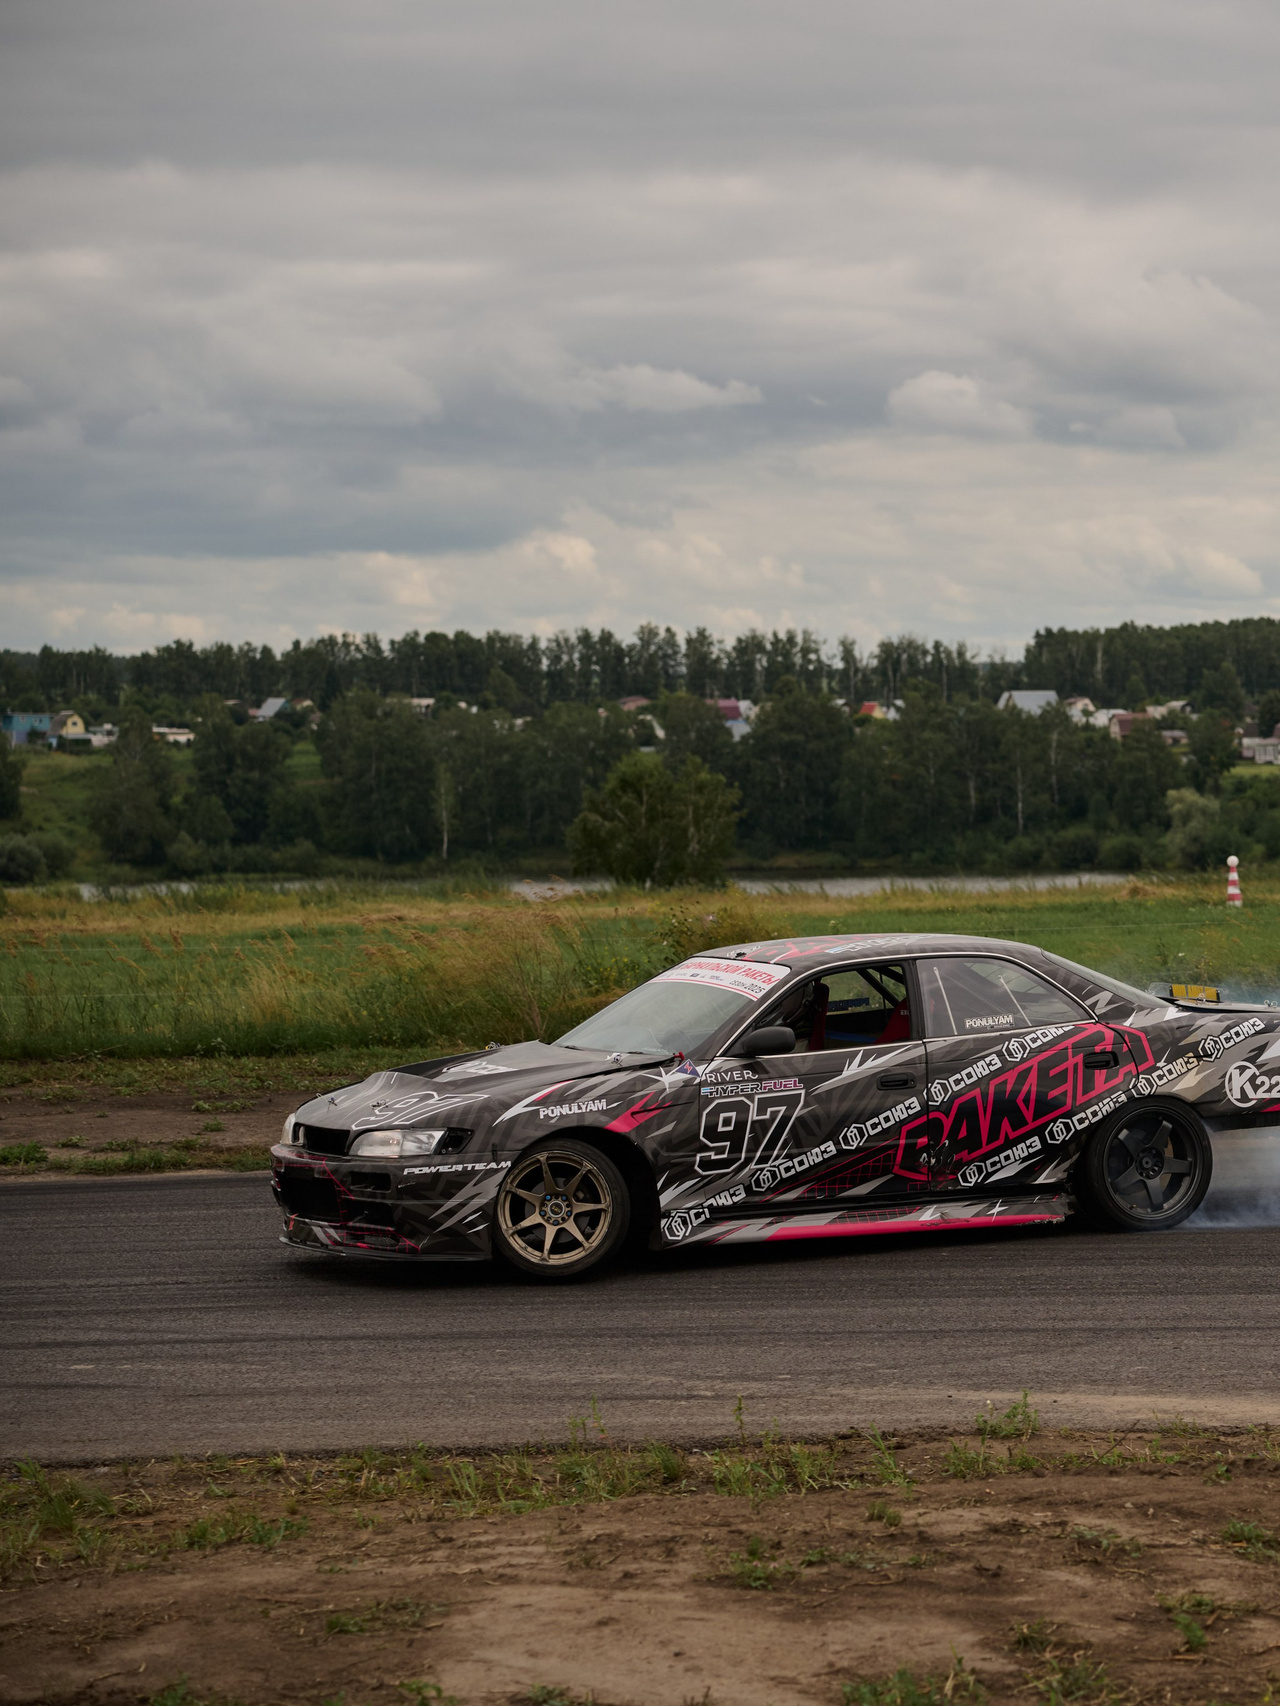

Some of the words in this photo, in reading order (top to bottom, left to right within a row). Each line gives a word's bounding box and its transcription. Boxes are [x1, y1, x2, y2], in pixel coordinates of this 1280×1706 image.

[739, 967, 781, 986] РАКЕТЫ
[745, 982, 766, 994] 2025
[965, 1014, 1014, 1028] PONULYAM
[706, 1070, 758, 1083] RIVER
[949, 1053, 1002, 1092] СОЮЗ
[351, 1091, 491, 1131] 97
[539, 1099, 607, 1119] PONULYAM
[865, 1097, 921, 1136] СОЮЗ
[695, 1089, 806, 1175] 97
[780, 1140, 837, 1179] СОЮЗ
[986, 1136, 1042, 1173] СОЮЗ
